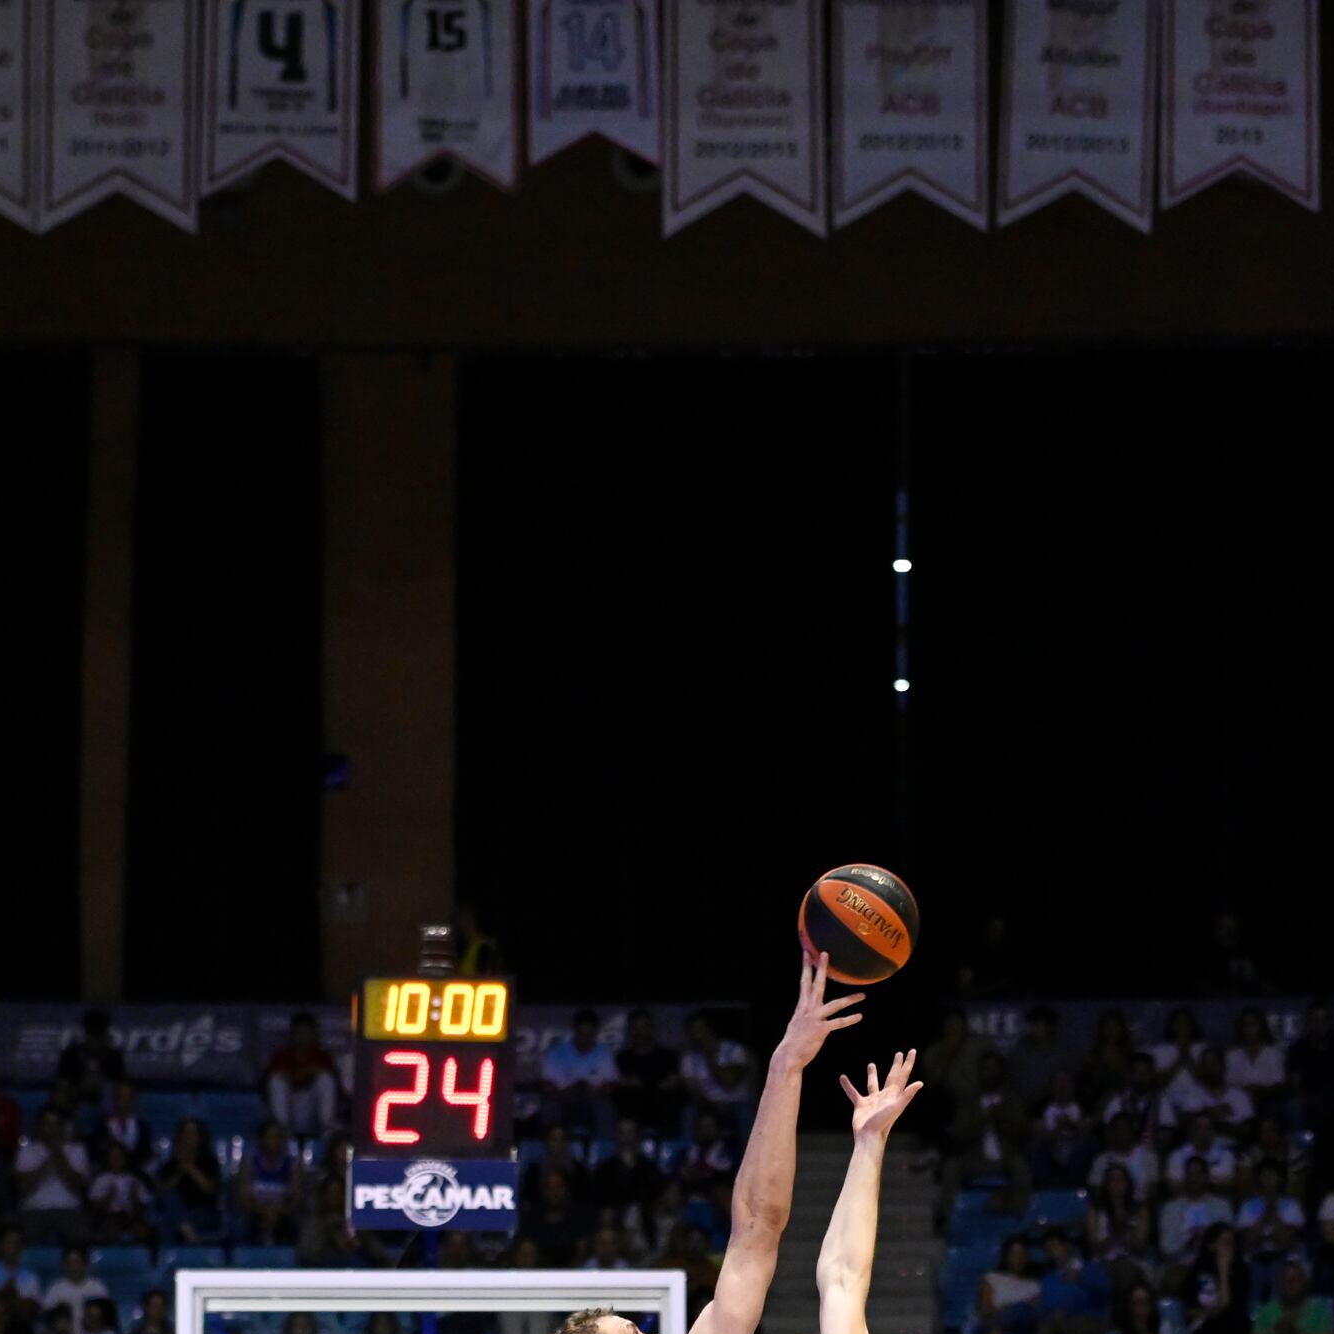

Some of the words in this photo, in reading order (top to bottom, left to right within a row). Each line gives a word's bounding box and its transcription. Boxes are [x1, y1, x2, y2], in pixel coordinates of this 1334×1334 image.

[257, 9, 308, 84] 4
[425, 8, 468, 53] 15
[557, 9, 628, 74] 14
[836, 886, 906, 949] SPALDING
[384, 983, 507, 1036] 10:00
[374, 1051, 494, 1144] 24
[354, 1175, 516, 1216] PESCAMAR
